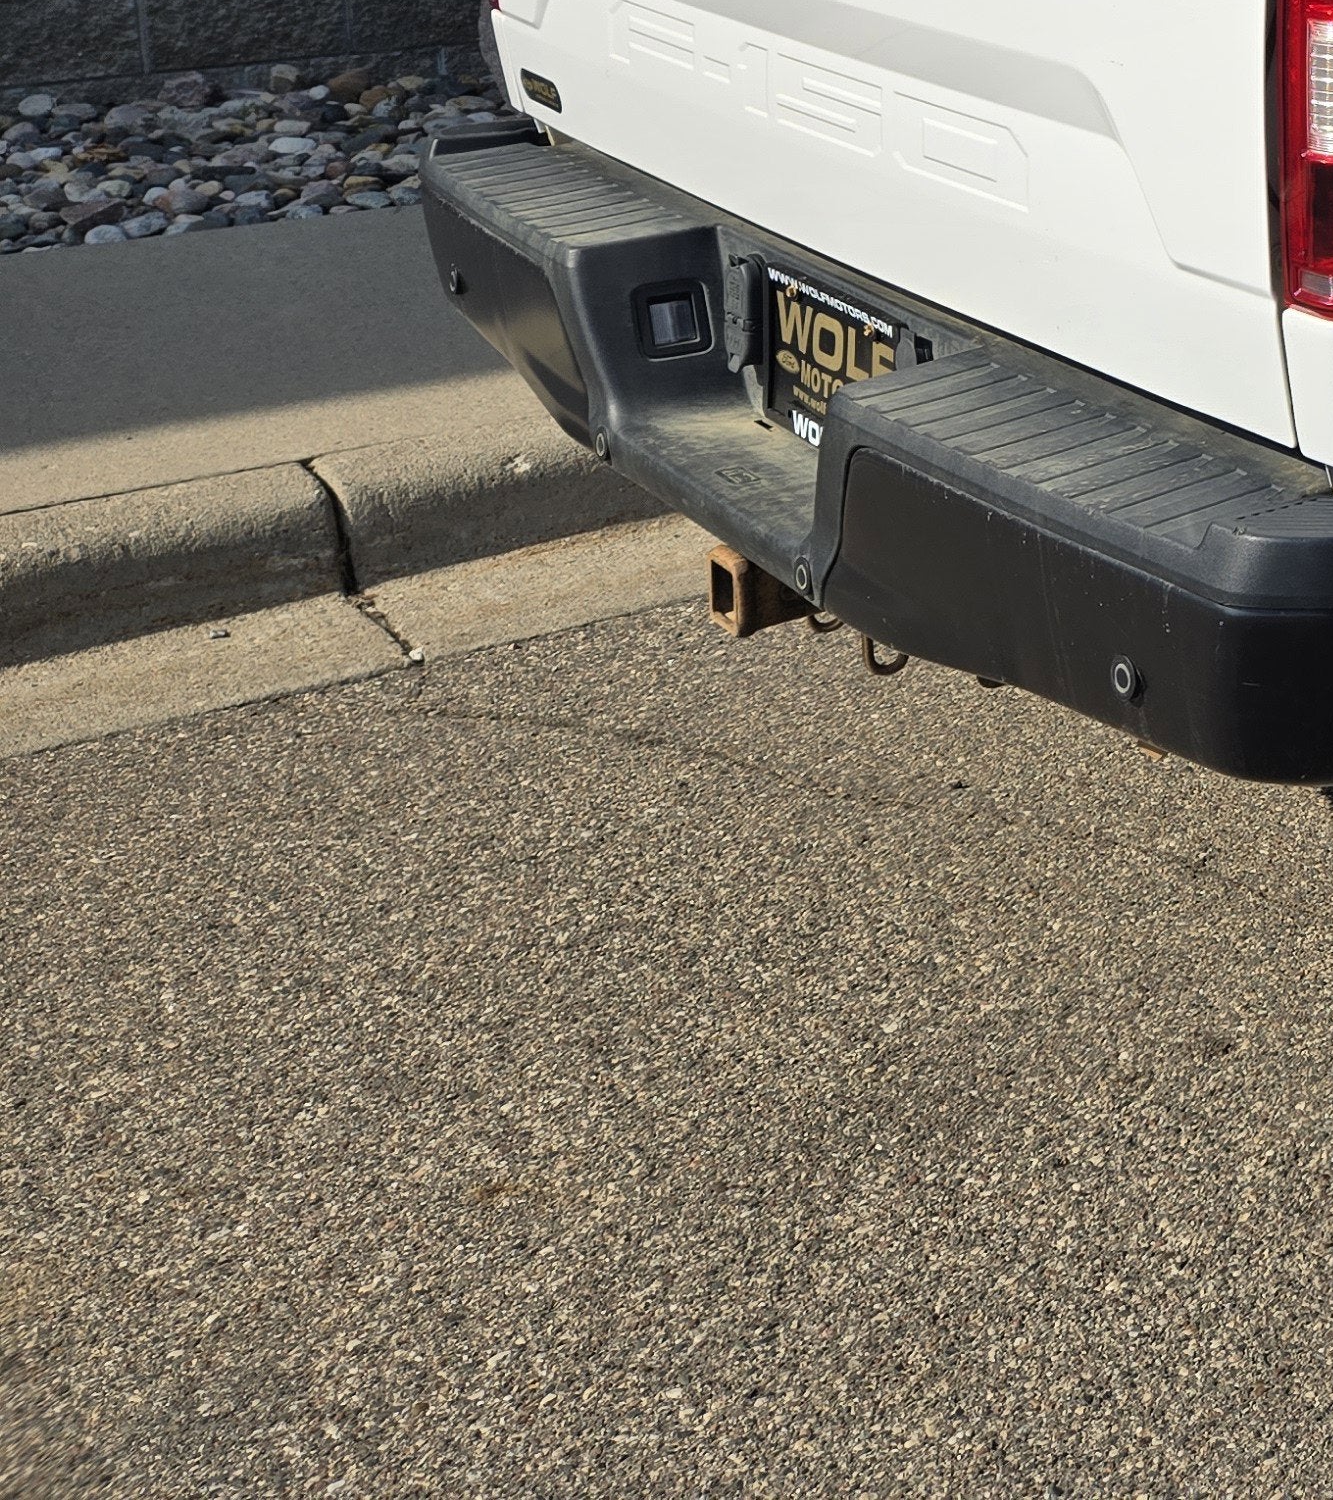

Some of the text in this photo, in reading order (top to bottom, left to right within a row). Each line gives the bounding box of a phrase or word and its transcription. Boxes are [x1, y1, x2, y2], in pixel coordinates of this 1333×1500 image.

[609, 0, 1030, 213] F-150
[776, 290, 894, 378] WOLF
[792, 410, 824, 447] WO
